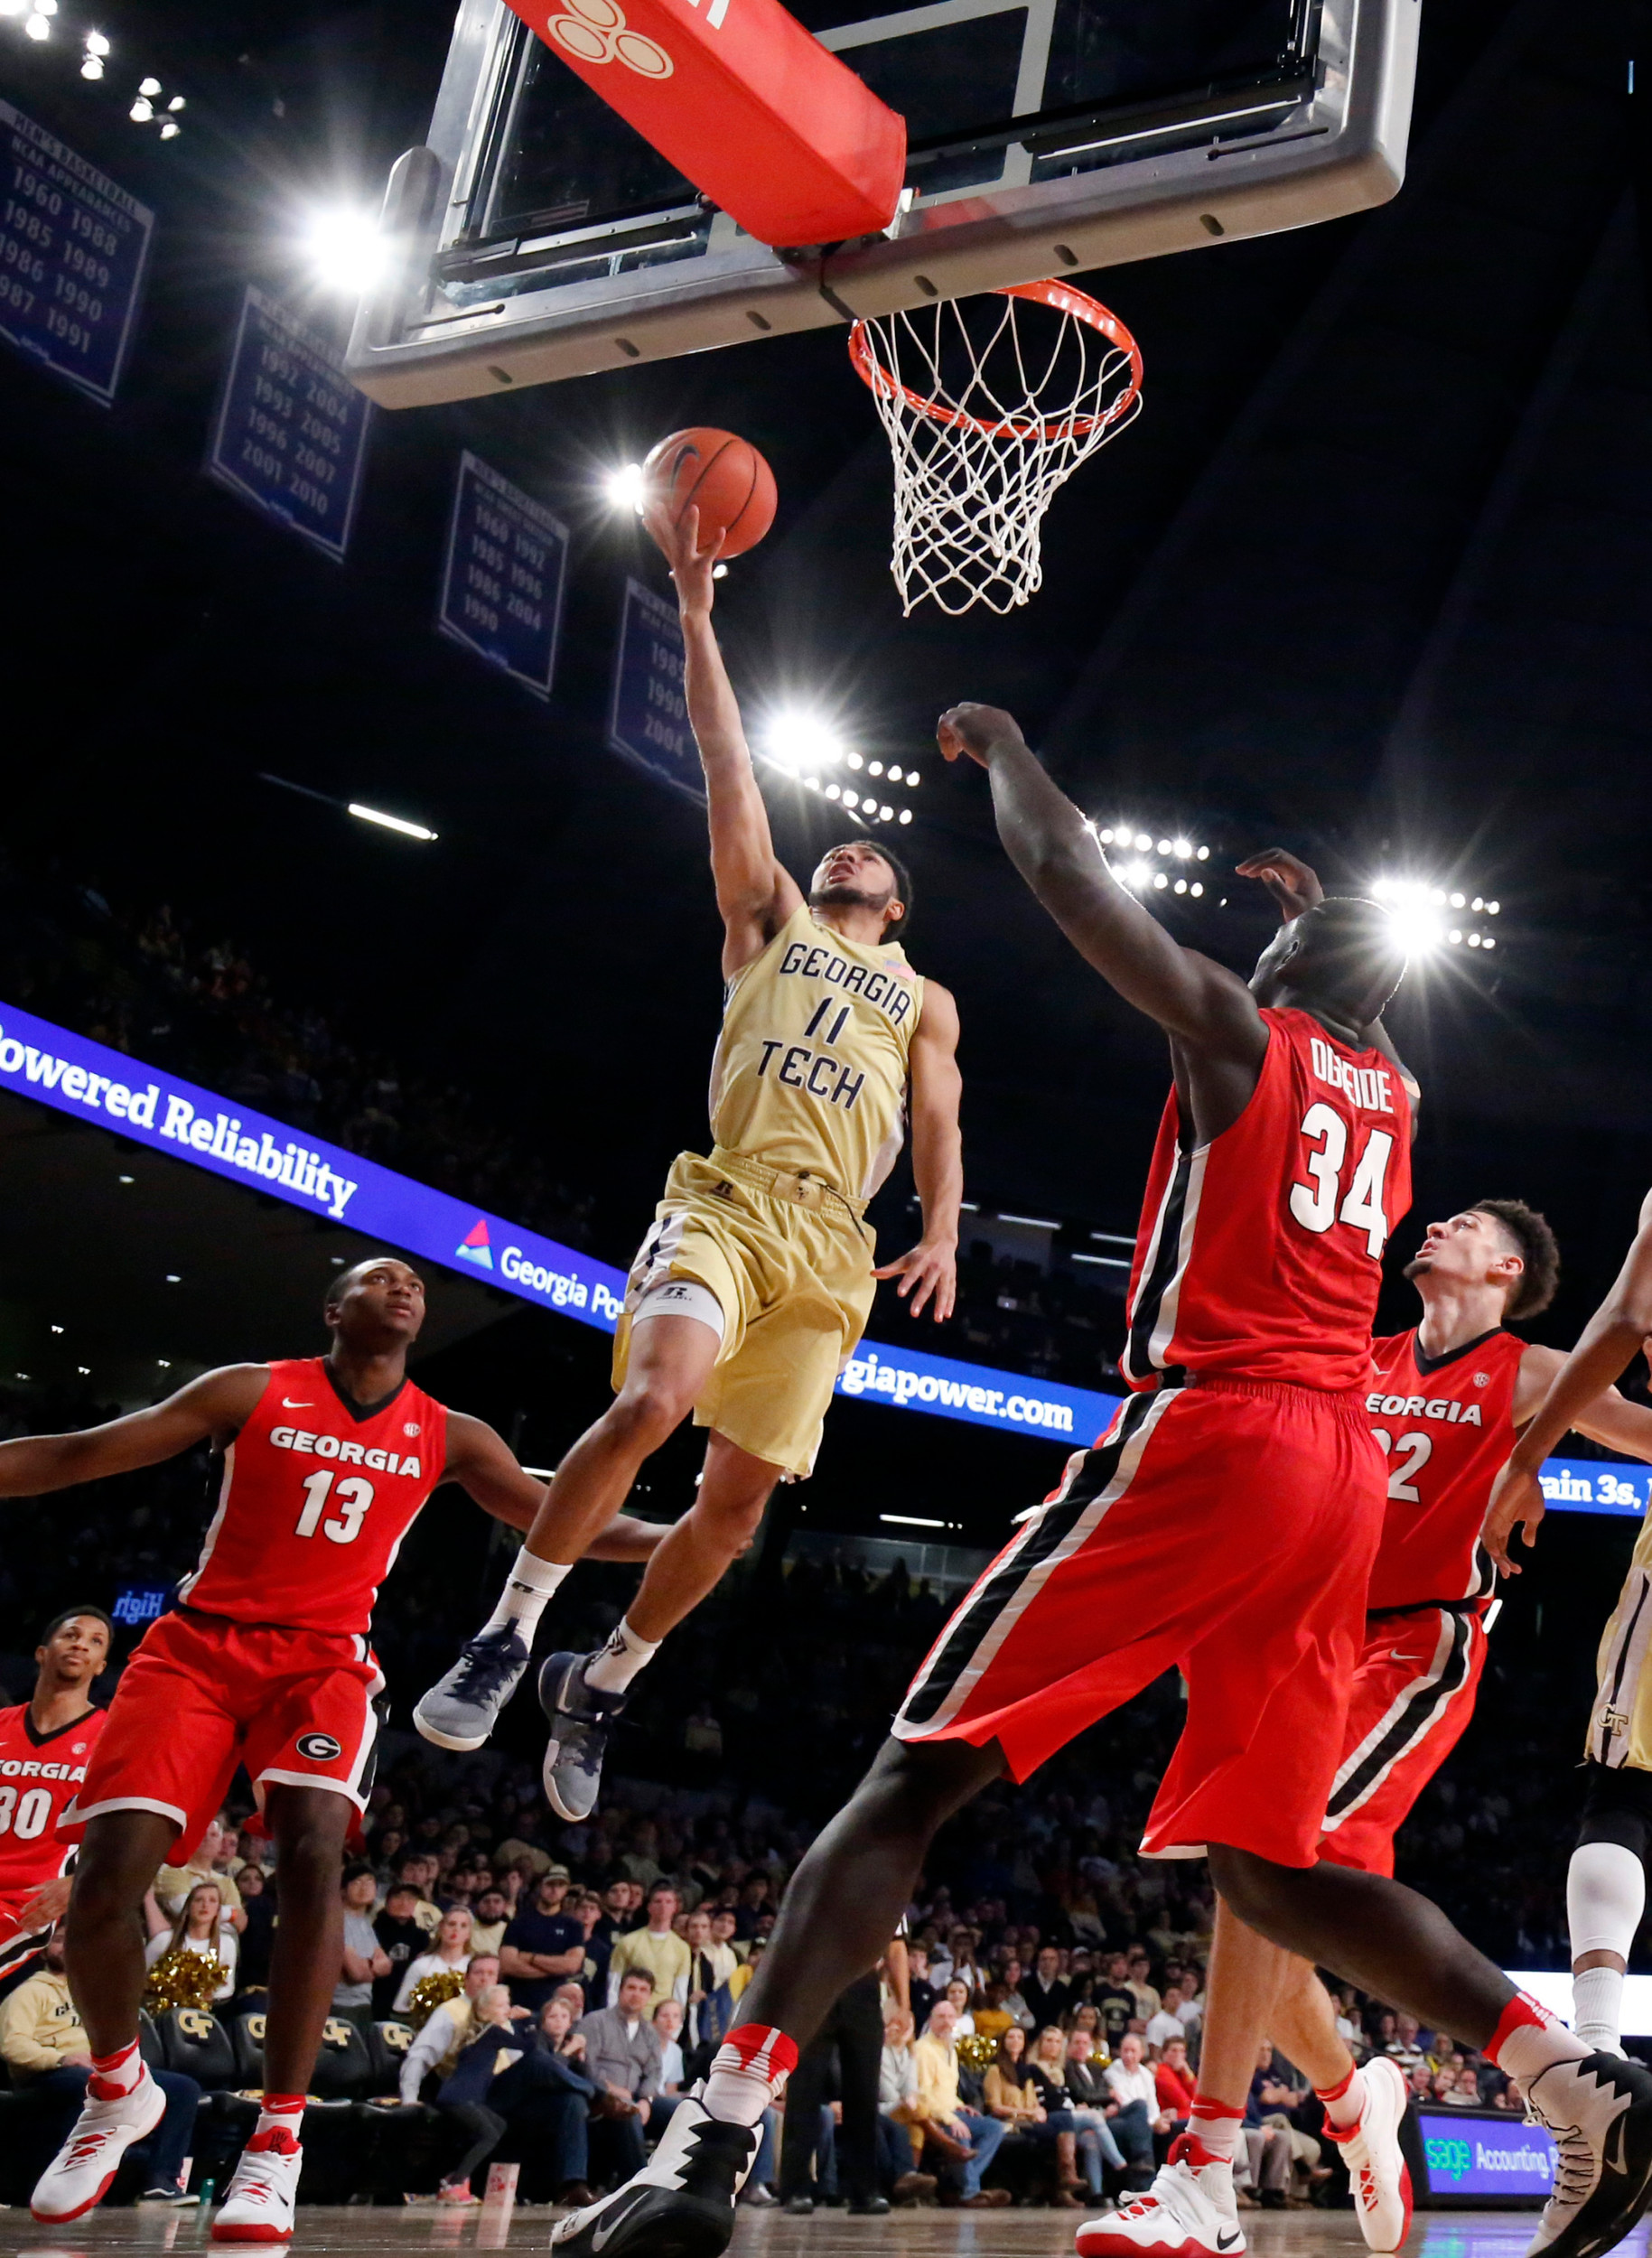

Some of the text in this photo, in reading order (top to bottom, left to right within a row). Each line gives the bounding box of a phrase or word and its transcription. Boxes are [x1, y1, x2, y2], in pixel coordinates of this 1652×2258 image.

[12, 135, 131, 233] NCAA APPEARANCES
[14, 166, 117, 257] 1960 1988
[5, 200, 109, 288] 1985 1989
[0, 275, 35, 313] 987
[47, 307, 91, 354] 1991
[55, 274, 103, 322] 1990
[307, 380, 348, 425] 2004
[302, 410, 341, 454] 2005
[242, 438, 283, 482] 2001
[290, 472, 328, 515] 2010
[295, 442, 336, 482] 2007
[507, 592, 541, 631] 2004
[644, 713, 685, 757] 2004
[779, 943, 910, 1026] GEORGIA
[804, 997, 851, 1045] 11
[757, 1040, 864, 1110] TECH
[0, 1022, 358, 1218] owered Reliability
[1289, 1102, 1394, 1261] 34
[500, 1246, 625, 1321] Georgia Po
[837, 1353, 1073, 1432] giapower.com
[1365, 1392, 1482, 1427] EORGIA
[269, 1425, 421, 1479] GEORGIA
[294, 1469, 375, 1544] 13
[1596, 1474, 1642, 1510] 3s,
[0, 1759, 87, 1784] ORGIA
[305, 1736, 341, 1757] G
[248, 2016, 266, 2039] G
[1424, 2138, 1472, 2181] sage
[1476, 2141, 1552, 2180] Accounting
